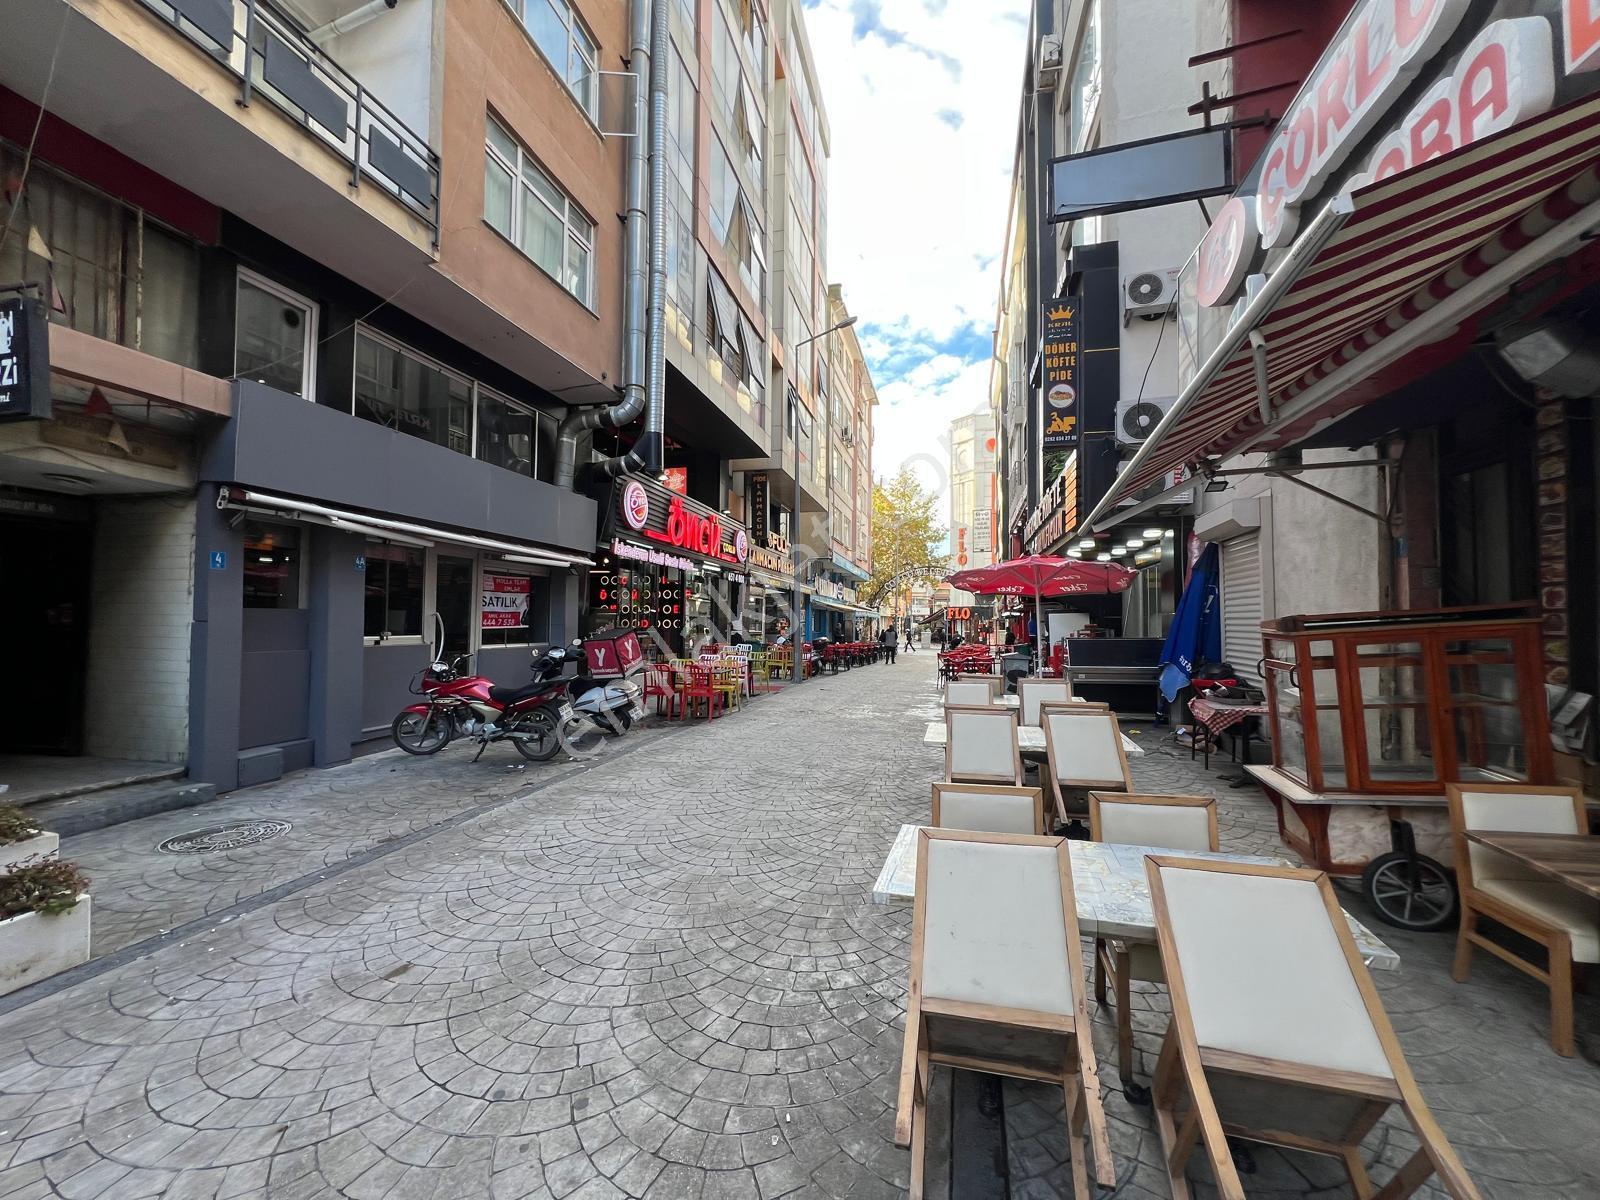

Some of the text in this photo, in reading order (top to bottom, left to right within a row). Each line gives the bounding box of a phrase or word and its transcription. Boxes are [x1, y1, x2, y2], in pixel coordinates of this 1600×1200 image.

[1044, 341, 1077, 355] DÖNER
[1046, 355, 1076, 367] KÖFTE
[1049, 369, 1073, 382] PİDE
[958, 527, 968, 566] FLO
[215, 552, 222, 564] 4
[355, 557, 365, 566] 4A
[482, 595, 518, 608] SATILIK
[947, 607, 971, 620] FLO
[624, 638, 633, 660] Y
[594, 647, 606, 667] Y
